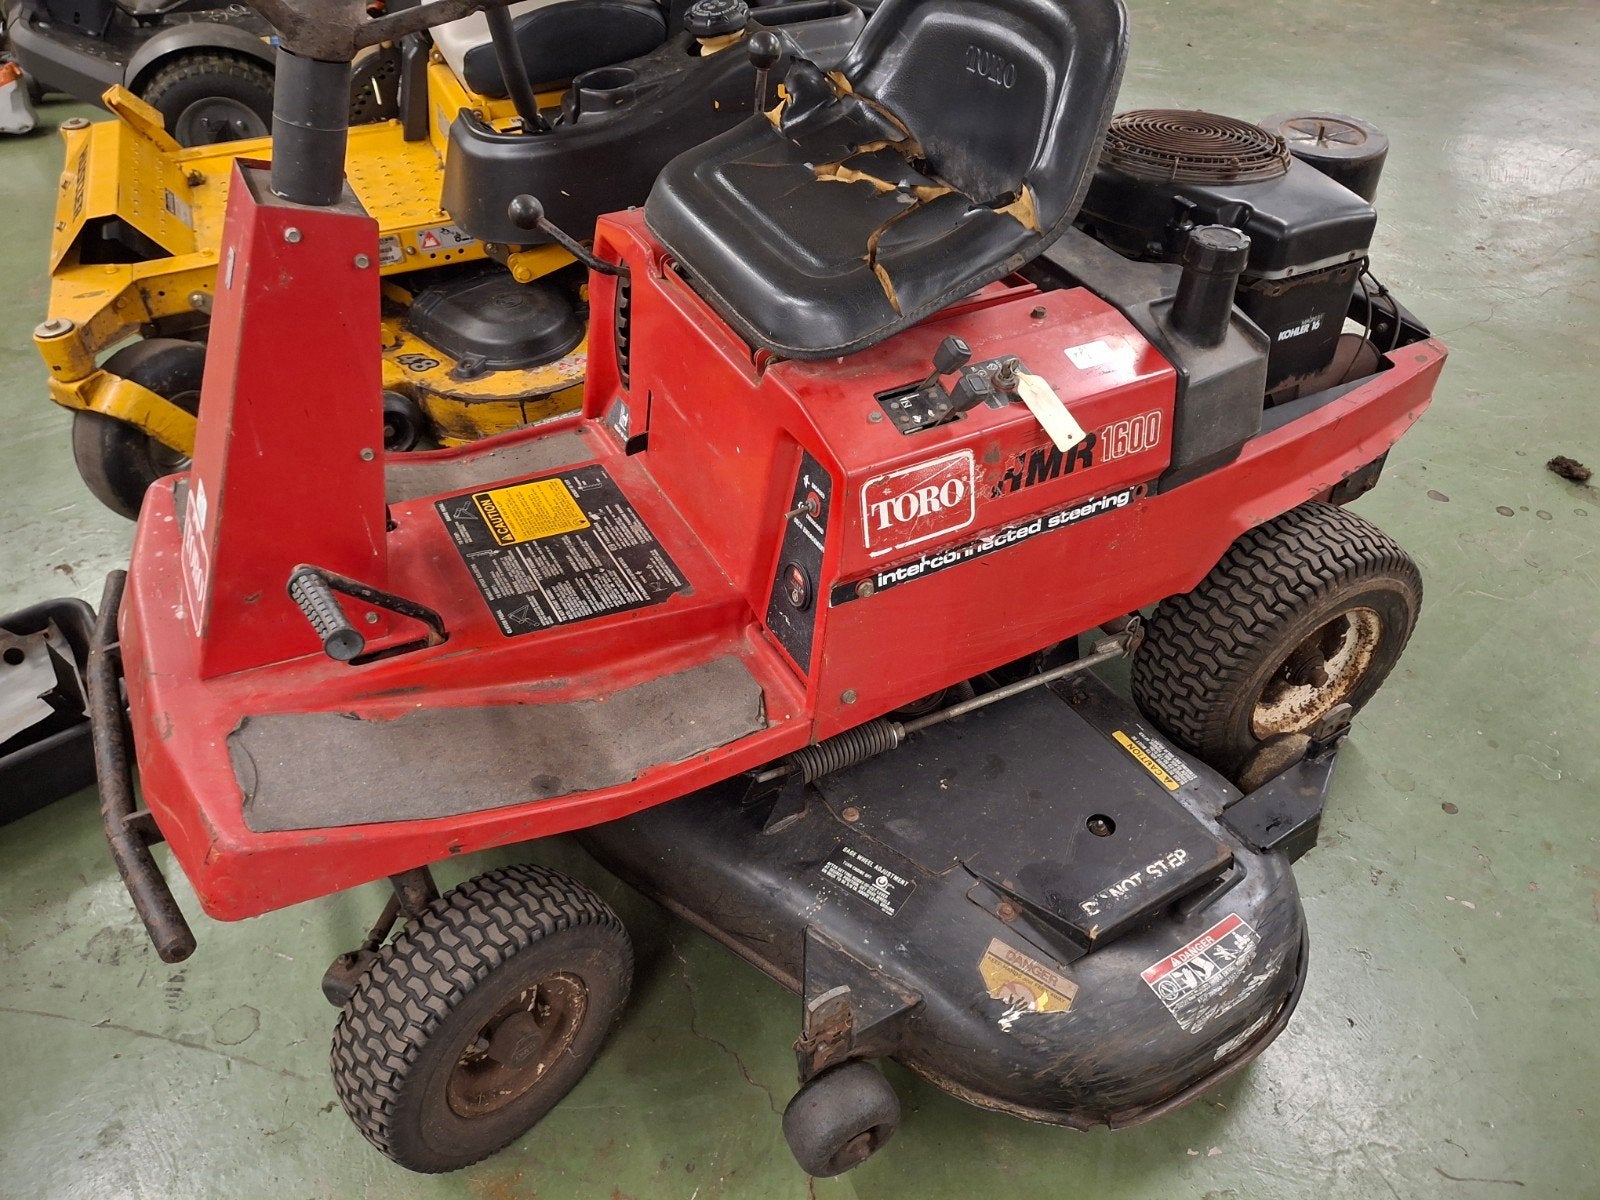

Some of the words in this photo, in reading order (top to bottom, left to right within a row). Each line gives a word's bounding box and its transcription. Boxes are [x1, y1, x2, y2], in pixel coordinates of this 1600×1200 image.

[1277, 323, 1310, 341] KOHLER
[1311, 319, 1321, 331] 16
[397, 353, 440, 372] 48
[1101, 411, 1161, 462] 1600
[480, 499, 508, 535] CAUTION
[871, 478, 965, 531] TORO
[877, 519, 1042, 587] interconnected
[1048, 491, 1130, 528] steering
[1126, 743, 1162, 776] CAUTION
[1109, 872, 1142, 900] NOT
[1146, 848, 1187, 879] STEP
[1179, 935, 1216, 963] DANGER
[1006, 949, 1059, 987] DANGER
